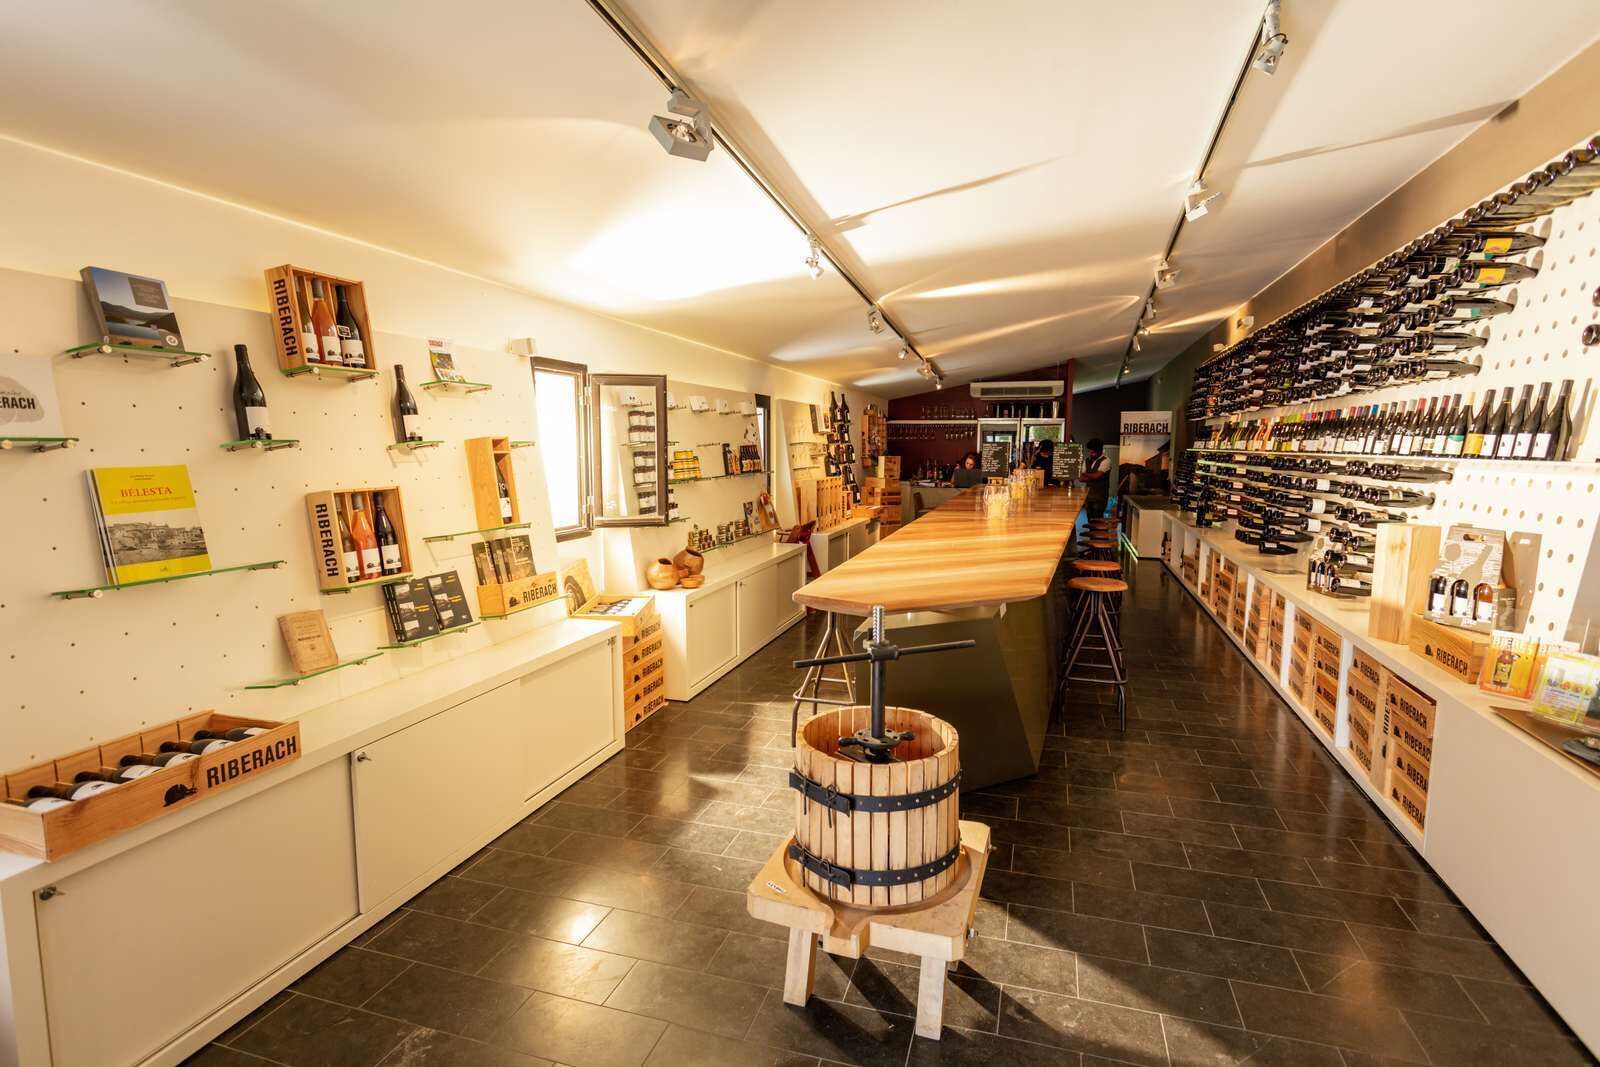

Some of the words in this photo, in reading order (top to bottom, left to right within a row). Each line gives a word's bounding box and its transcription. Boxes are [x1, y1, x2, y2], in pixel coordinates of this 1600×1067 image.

[273, 279, 298, 356] RIBERACH
[1123, 422, 1169, 433] RIBERACH
[315, 503, 339, 577] RIBERACH
[523, 583, 557, 603] RIBERACH
[1436, 647, 1468, 676] RIBERACH
[1400, 698, 1427, 730] RIBERACH
[206, 735, 297, 789] RIBERACH
